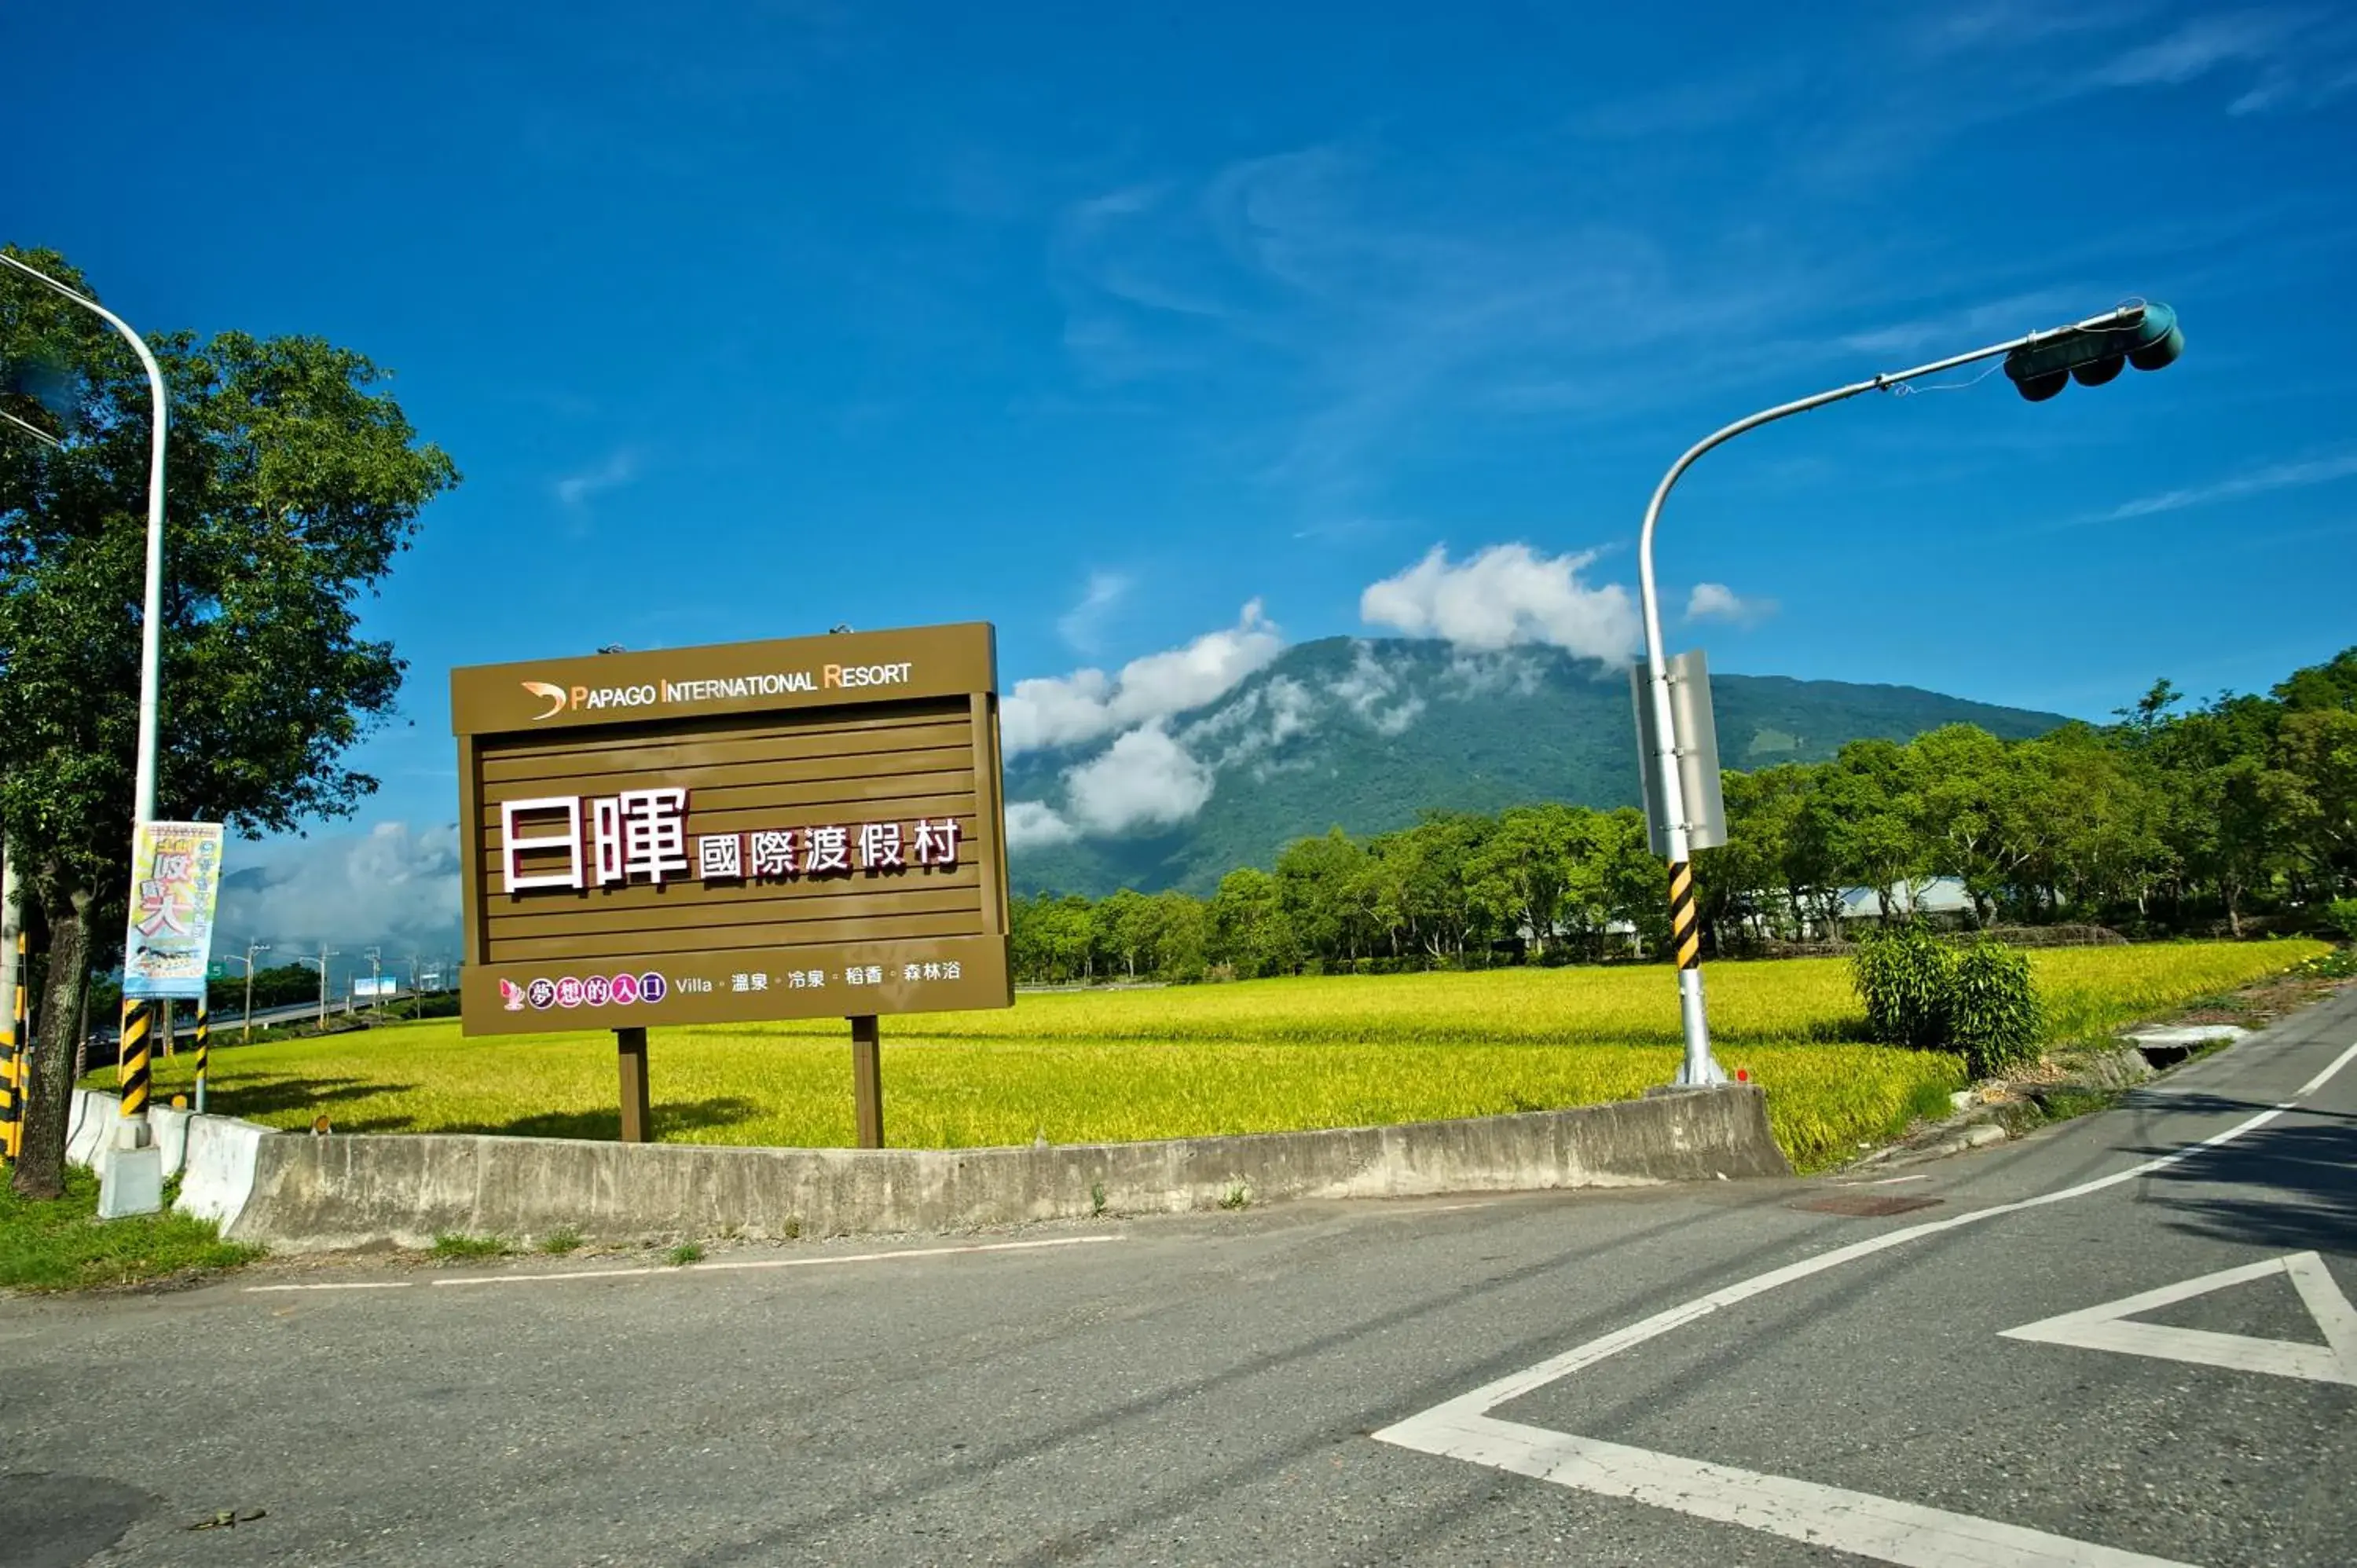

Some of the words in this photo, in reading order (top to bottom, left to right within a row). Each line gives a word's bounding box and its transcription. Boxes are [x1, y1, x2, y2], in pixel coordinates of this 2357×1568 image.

[571, 685, 656, 710] PAPAGO
[662, 672, 817, 702] INTERNATIONAL
[823, 662, 912, 688] RESORT
[698, 818, 959, 879] 國際渡假村
[531, 978, 660, 1005] 夢想的入口
[675, 977, 712, 994] Villa
[788, 970, 824, 988] 冷泉
[845, 965, 882, 985] 稻香
[904, 961, 961, 981] 森林浴
